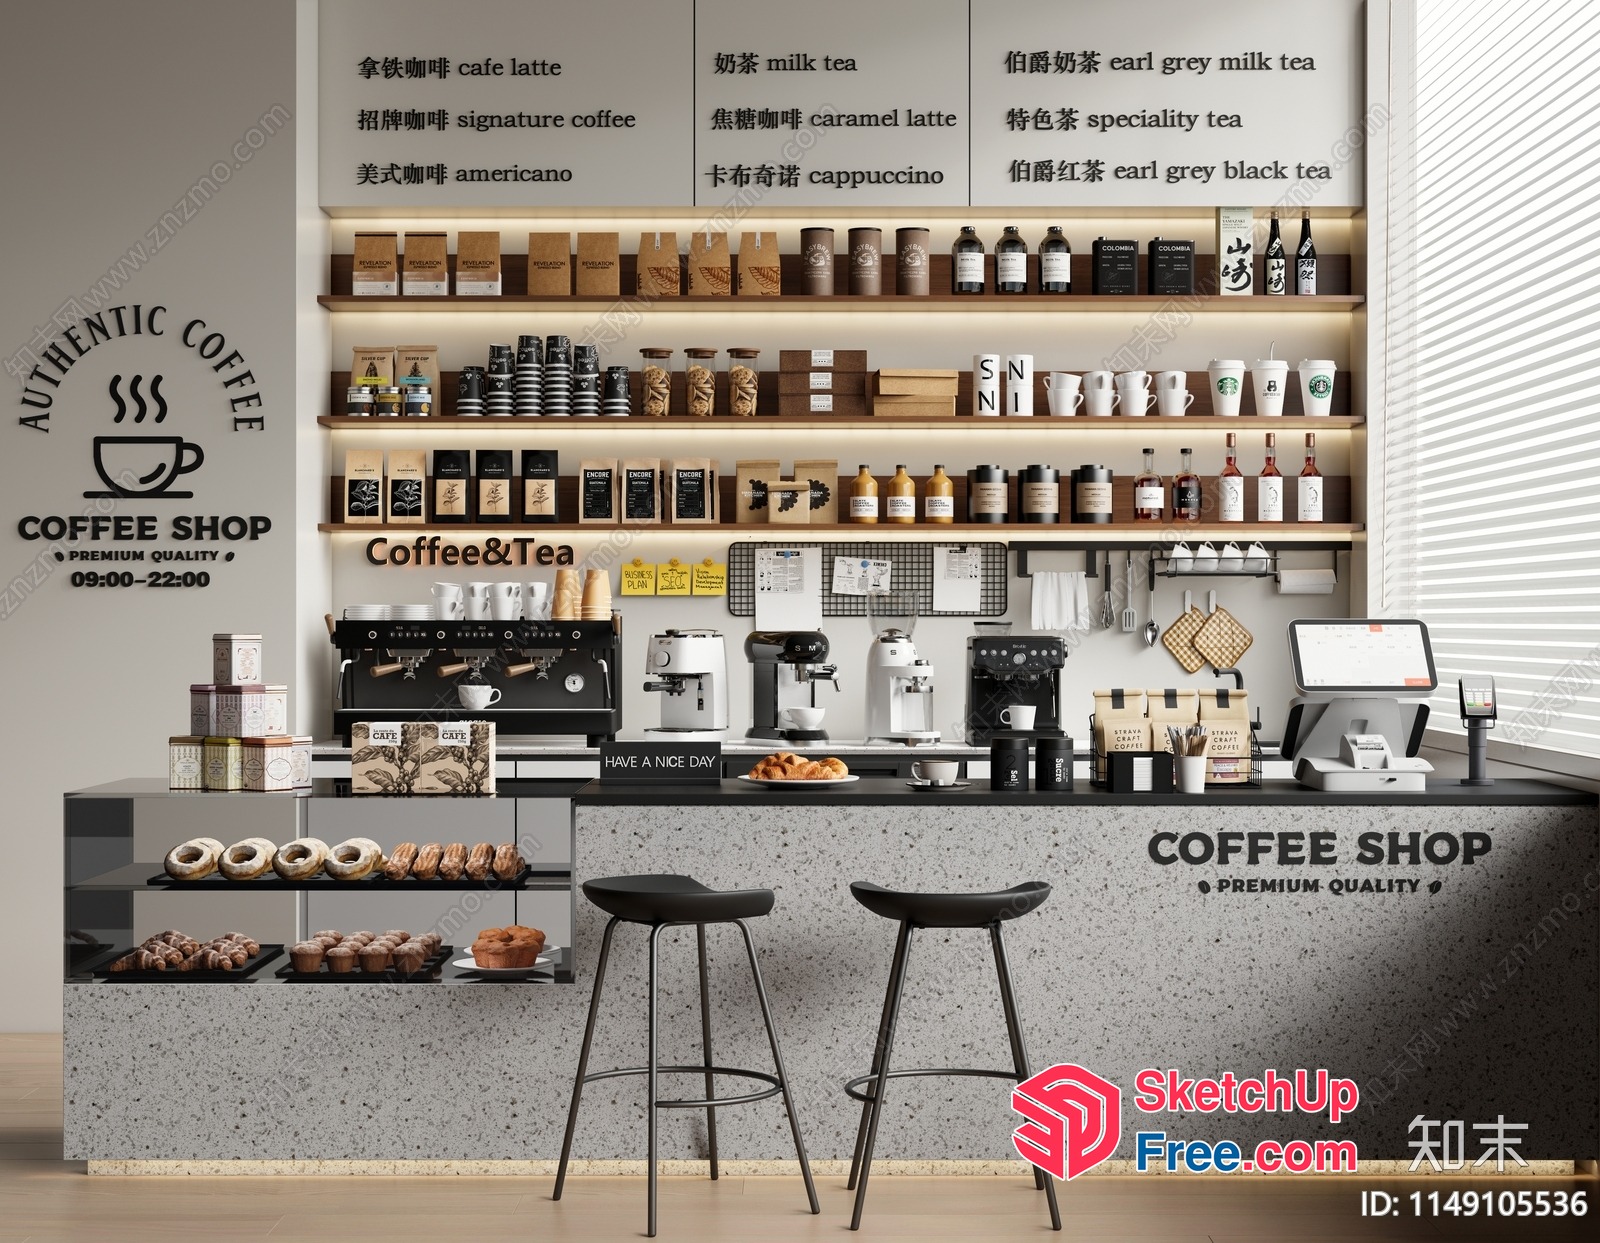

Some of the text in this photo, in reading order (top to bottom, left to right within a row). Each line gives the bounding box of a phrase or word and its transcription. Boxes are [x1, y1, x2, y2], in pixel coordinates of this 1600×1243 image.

[358, 57, 562, 79] 拿铁咖啡 cafe latte
[714, 52, 857, 75] 奶茶 milk tea
[1005, 51, 1316, 75] 伯爵奶茶 earl grey milk tea
[357, 109, 636, 132] 招牌咖啡 signature coffee
[711, 108, 957, 131] 焦糖咖啡 caramel latte
[1007, 108, 1242, 132] 特色茶 speciality tea
[357, 163, 572, 185] 美式咖啡 americano
[705, 163, 944, 188] 卡布奇诺 cappuccino
[1009, 159, 1331, 184] 伯爵红茶 earl grey black tea
[19, 304, 266, 434] AUTHENTIC COFFEE
[980, 358, 994, 380] S
[1008, 359, 1024, 381] N
[978, 390, 995, 411] N
[18, 515, 272, 541] COFFEE SHOP
[69, 550, 220, 563] PREMIUM QUALITY
[366, 535, 575, 568] Coffee&Tea
[624, 570, 653, 579] BUSINESS
[627, 580, 648, 590] PLAN
[663, 575, 682, 588] SEO
[372, 732, 398, 740] CAFE
[441, 732, 467, 740] CAFE
[1114, 742, 1143, 750] COFFEE
[605, 755, 716, 768] HAVE A NICE DAY
[1055, 757, 1064, 783] Sucre
[1010, 769, 1018, 782] Sel
[1149, 831, 1493, 866] COFFEE SHOP
[1218, 879, 1420, 895] PREMIUM QUALITY
